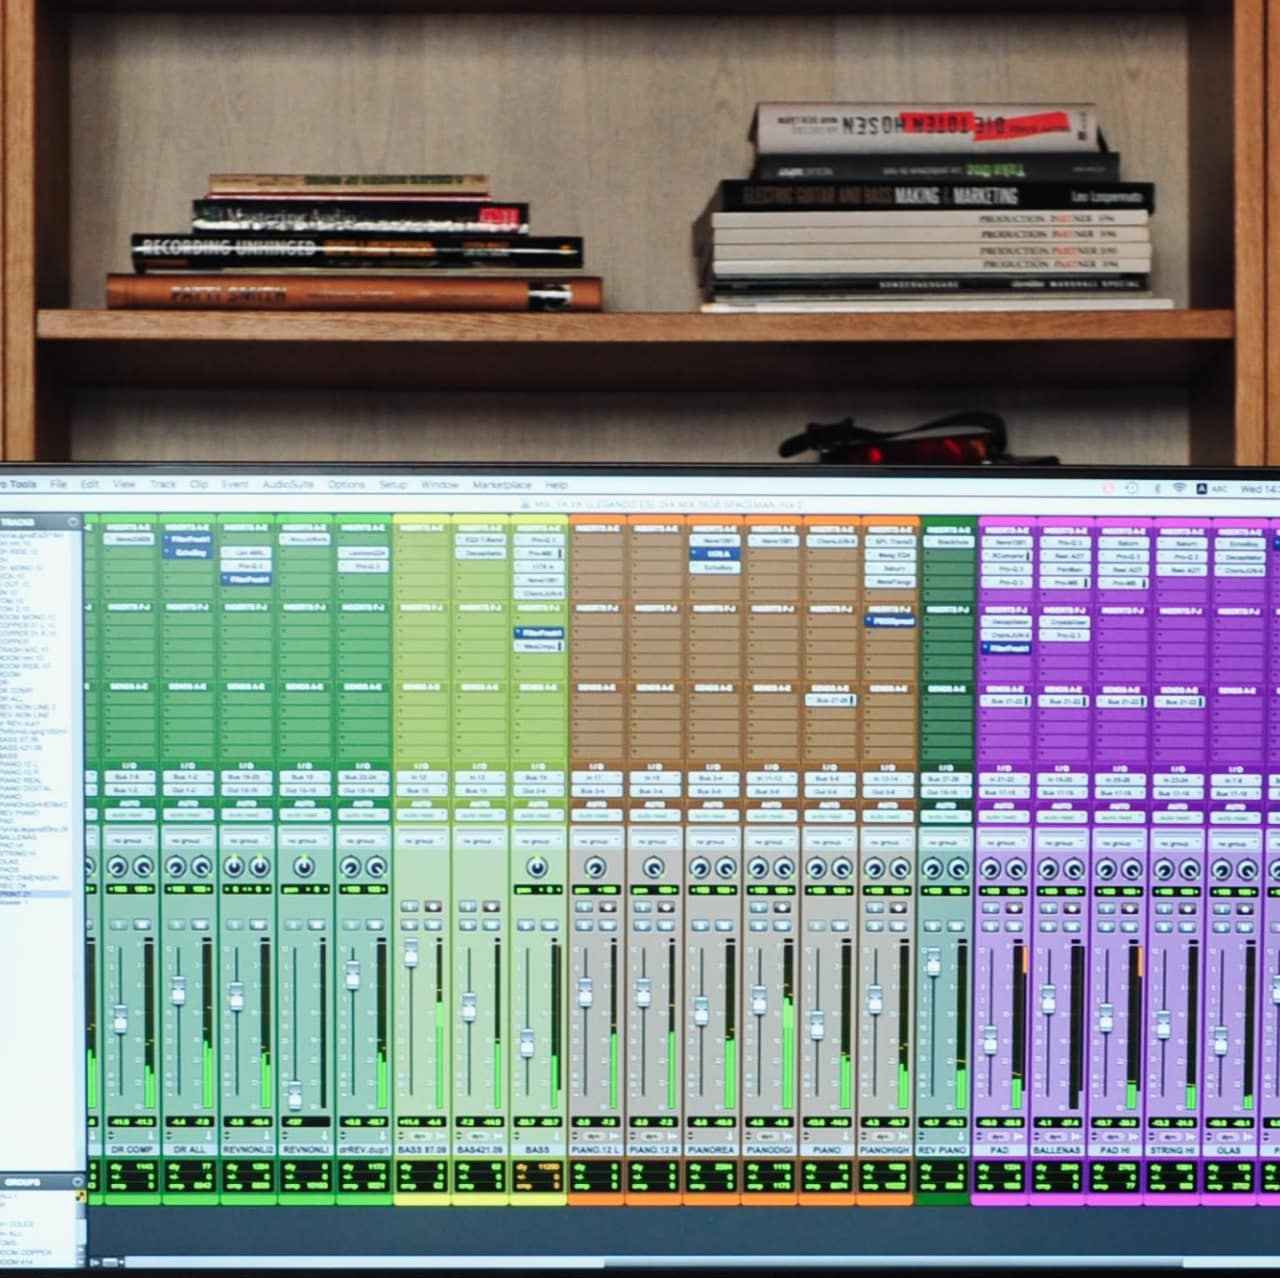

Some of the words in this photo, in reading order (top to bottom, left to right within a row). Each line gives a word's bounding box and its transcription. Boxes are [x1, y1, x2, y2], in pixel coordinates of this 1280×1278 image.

[842, 115, 905, 135] HOSEN
[953, 187, 1018, 204] MARKETING
[143, 239, 231, 256] RECORDING
[236, 239, 317, 256] UNHINGED
[9, 479, 37, 489] Tools
[50, 479, 68, 489] File
[80, 479, 100, 489] Edit
[114, 480, 136, 489] View
[150, 479, 176, 489] Track
[328, 479, 366, 490] Options
[421, 481, 460, 489] Window
[1240, 485, 1263, 494] Wed
[525, 1145, 550, 1154] BASS
[812, 1146, 841, 1154] PIANO
[918, 1146, 936, 1154] REV
[938, 1146, 966, 1154] PIANO
[990, 1146, 1009, 1155] PAD
[1100, 1146, 1119, 1155] PAD
